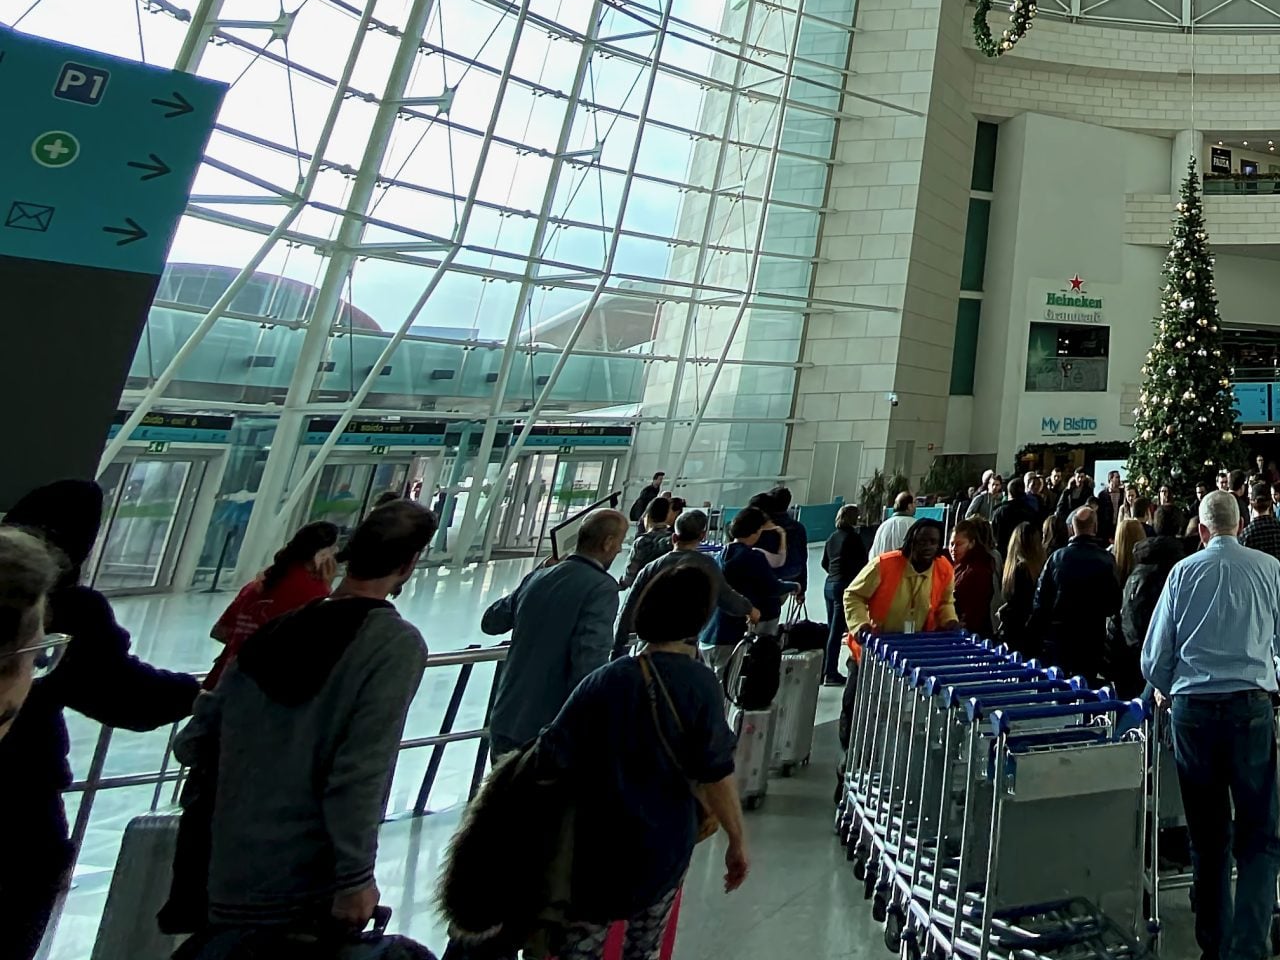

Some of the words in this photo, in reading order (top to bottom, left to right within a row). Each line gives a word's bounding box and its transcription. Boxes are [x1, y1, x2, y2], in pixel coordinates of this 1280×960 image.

[60, 69, 104, 99] P1
[1046, 292, 1102, 309] Heineken
[1041, 416, 1060, 433] My
[1063, 417, 1098, 431] Bistro
